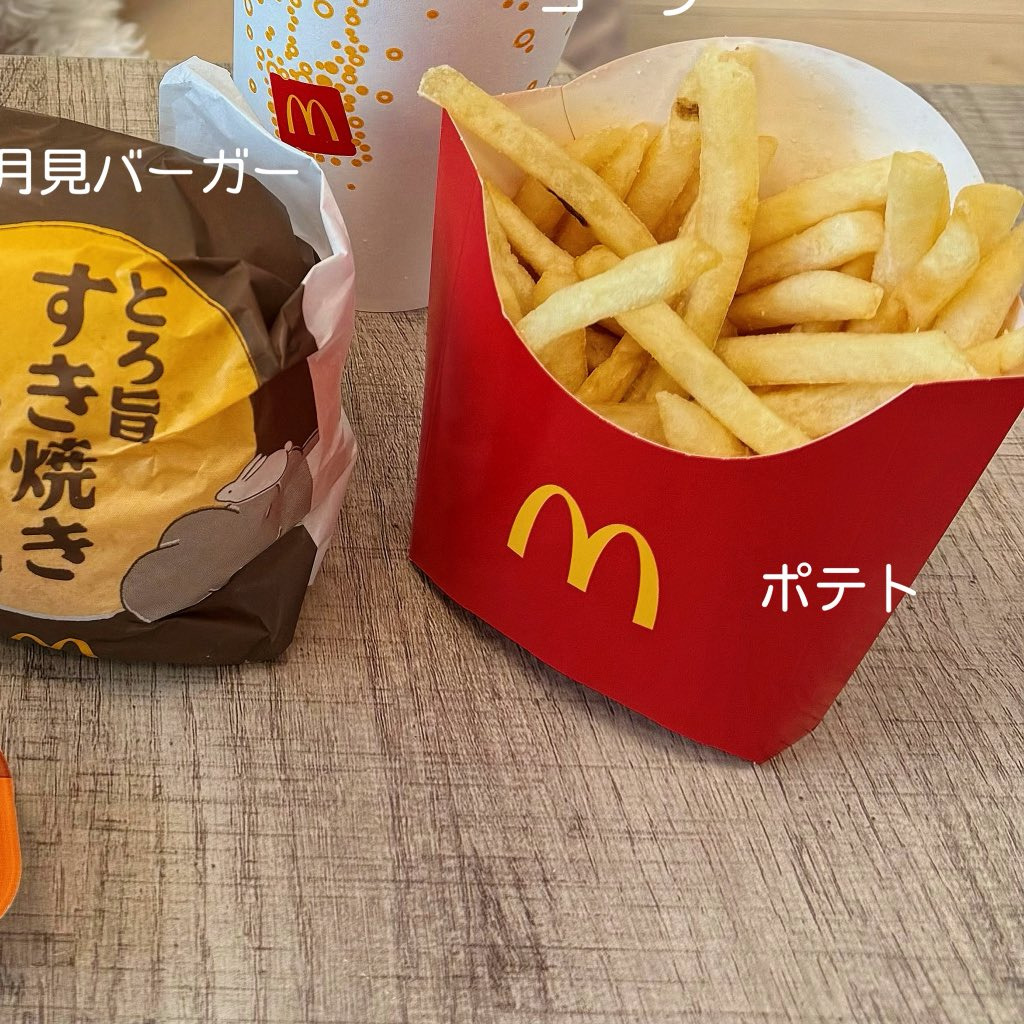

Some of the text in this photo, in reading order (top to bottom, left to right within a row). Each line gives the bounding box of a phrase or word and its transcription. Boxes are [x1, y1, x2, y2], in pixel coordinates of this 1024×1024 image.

[11, 262, 116, 581] すき焼き
[108, 270, 168, 444] とろ旨
